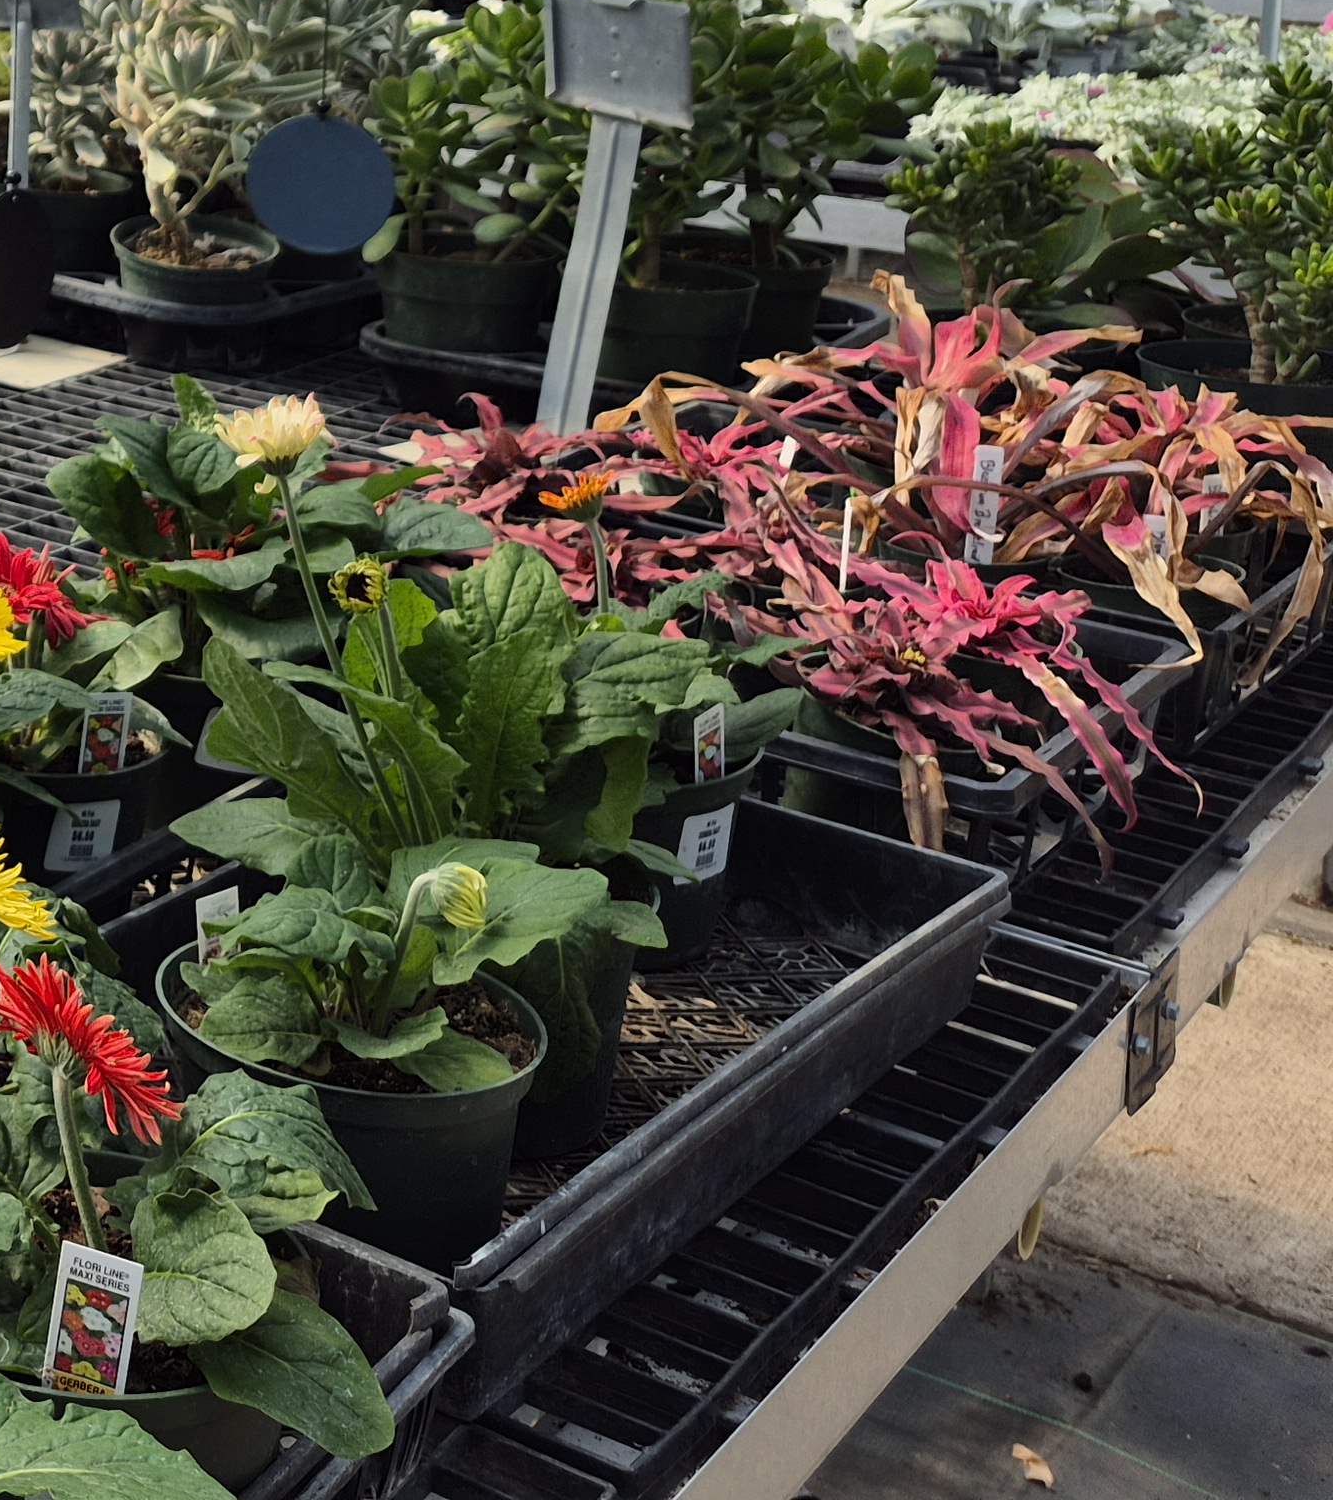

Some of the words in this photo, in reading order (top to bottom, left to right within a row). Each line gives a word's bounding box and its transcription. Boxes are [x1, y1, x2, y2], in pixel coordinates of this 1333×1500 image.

[73, 1256, 102, 1273] FLORI
[69, 1267, 94, 1281] MAXI
[95, 1274, 131, 1293] SERIES
[59, 1375, 106, 1395] GERBERA
